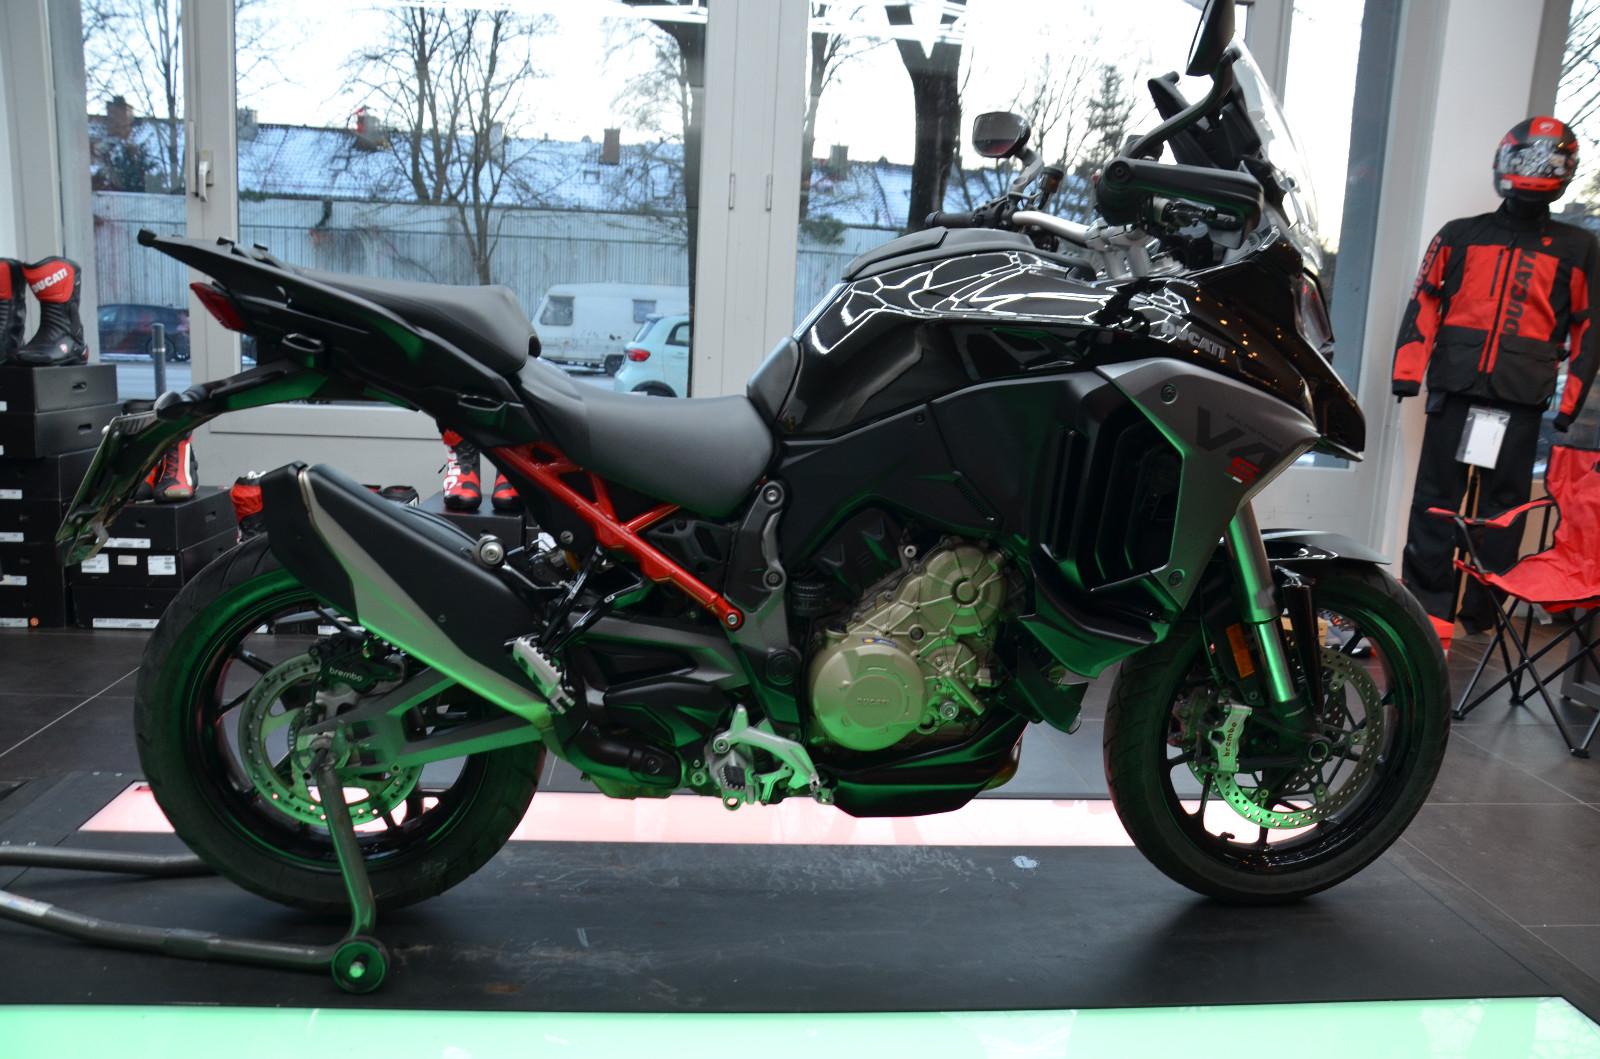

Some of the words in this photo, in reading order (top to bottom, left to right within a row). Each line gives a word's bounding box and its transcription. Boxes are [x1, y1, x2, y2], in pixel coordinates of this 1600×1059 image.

[32, 268, 68, 293] DUCATI
[1503, 250, 1536, 335] DUCATI
[1161, 322, 1226, 358] DUCATI
[329, 666, 363, 682] brembo
[1224, 722, 1237, 757] brembo
